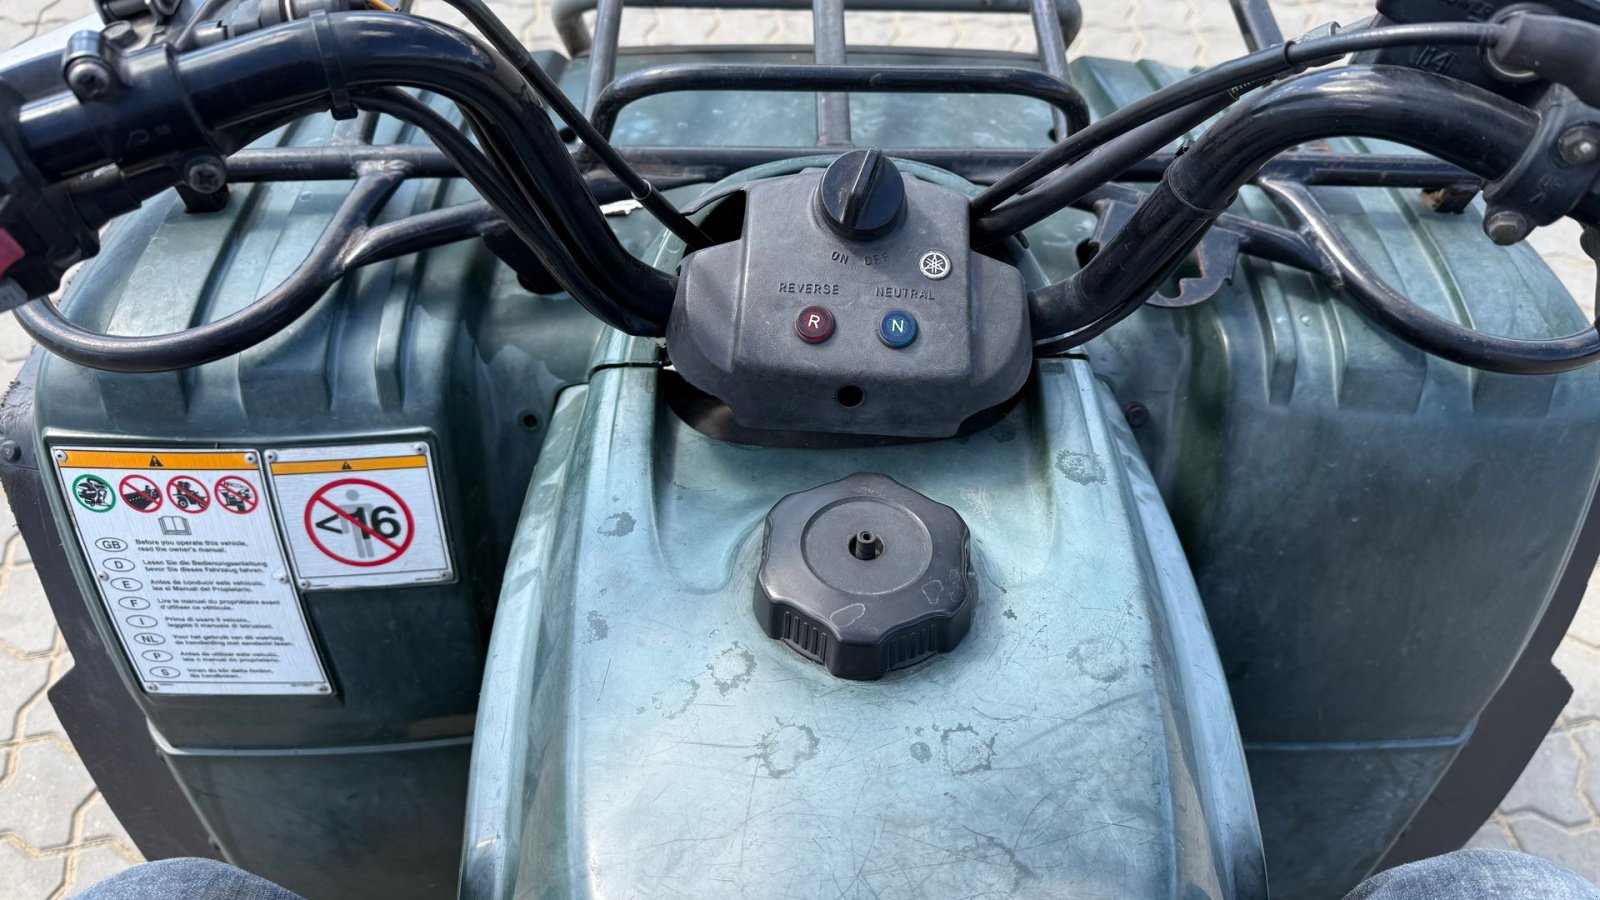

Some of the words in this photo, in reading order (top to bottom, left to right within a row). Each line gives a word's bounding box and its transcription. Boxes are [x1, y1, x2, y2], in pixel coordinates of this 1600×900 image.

[832, 251, 849, 264] ON
[864, 252, 888, 265] OFF
[779, 282, 839, 295] REVERSE
[876, 286, 935, 300] NEUTRAL
[807, 314, 820, 328] R
[892, 319, 904, 333] N
[102, 540, 121, 550] GB
[114, 560, 123, 569] D
[122, 580, 132, 589] E
[130, 599, 138, 607] F
[141, 635, 158, 643] NL
[160, 668, 169, 676] S
